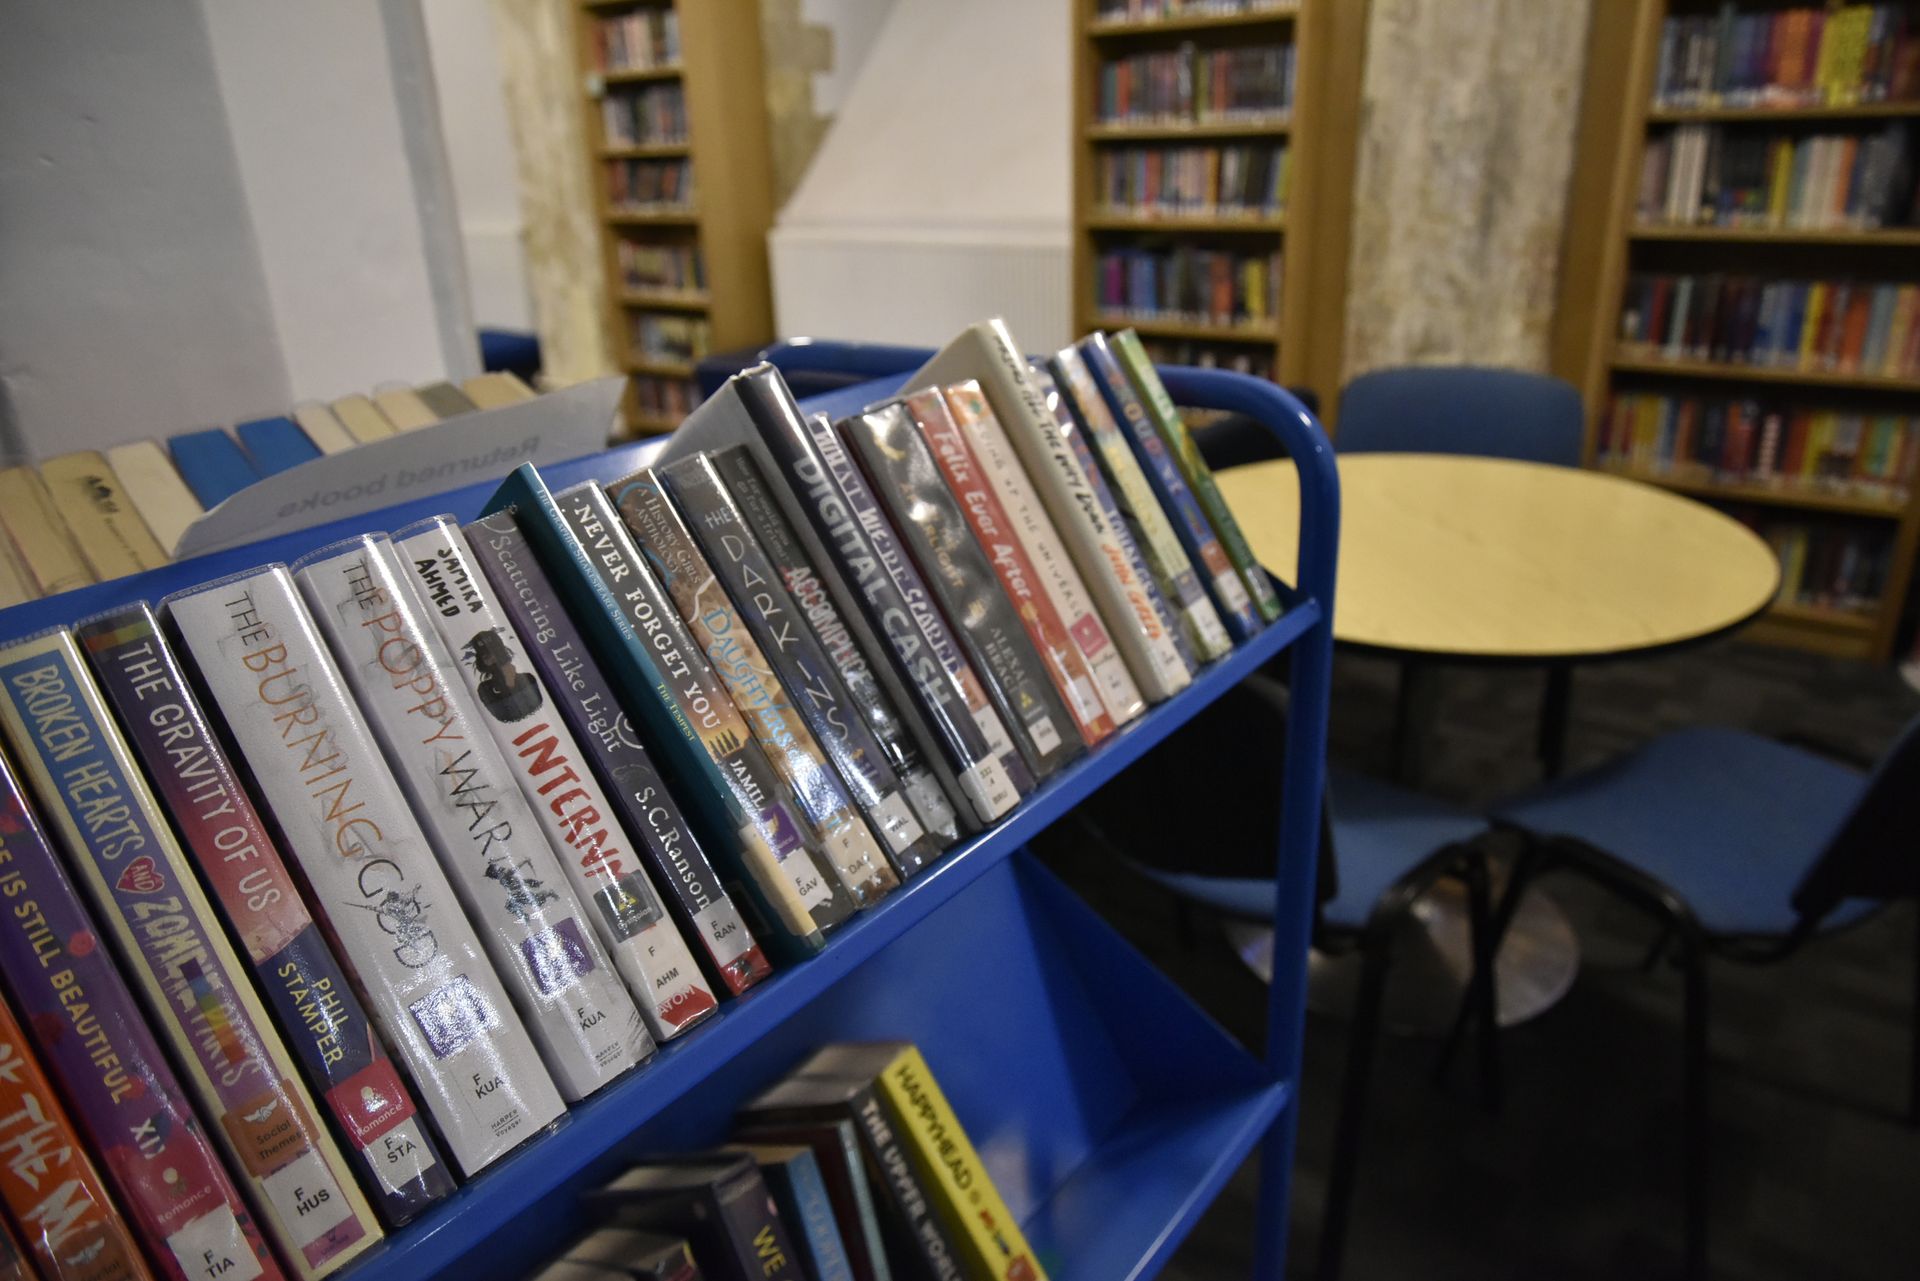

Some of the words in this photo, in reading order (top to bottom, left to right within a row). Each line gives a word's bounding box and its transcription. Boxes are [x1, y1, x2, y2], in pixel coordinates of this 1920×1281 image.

[814, 431, 865, 499] WHAT
[933, 432, 969, 483] Felix
[965, 490, 998, 537] Ever
[992, 543, 1031, 598] After
[1018, 505, 1036, 534] THE
[343, 558, 384, 610] THE
[415, 558, 461, 618] AHMED
[437, 546, 484, 614] SAMIRA
[793, 457, 888, 604] DIGITAL
[882, 607, 951, 709] CASH
[224, 590, 270, 647] THE
[489, 535, 557, 645] Scattering
[552, 642, 587, 692] Like
[582, 692, 621, 752] Light
[574, 504, 630, 583] NEVER
[625, 587, 691, 679] FORGET
[684, 681, 721, 729] YOU
[610, 609, 633, 641] SERIES
[787, 566, 874, 692] ACCOMPLICE
[362, 611, 464, 745] POPPY
[703, 607, 794, 748] DAUGHTERS
[656, 682, 671, 702] THE
[668, 700, 695, 742] TEMPEST
[12, 663, 95, 763] BROKEN
[64, 760, 146, 861] HEARTS
[131, 864, 155, 891] AND
[118, 642, 172, 701] THE
[149, 703, 236, 820] GRAVITY
[214, 825, 260, 862] OF
[238, 867, 281, 912] US
[242, 643, 383, 858] BURNING
[440, 749, 512, 856] WAR
[730, 758, 766, 812] JAMIL
[798, 878, 819, 897] GAV
[713, 921, 737, 942] RAN
[0, 870, 28, 898] IS
[14, 900, 61, 969] STILL
[50, 968, 132, 1105] BEAUTIFUL
[311, 977, 349, 1033] PHIL
[656, 967, 680, 990] AHM
[278, 962, 344, 1067] STAMPER
[579, 1010, 606, 1032] KUA
[475, 1076, 504, 1100] KUA
[0, 1091, 73, 1192] THE
[256, 1119, 291, 1145] Social
[355, 1103, 405, 1138] Romance
[490, 1108, 518, 1130] HARPER
[894, 1063, 974, 1191] HAPPYHEAD
[387, 1141, 417, 1163] STA
[861, 1097, 893, 1149] THE
[883, 1146, 926, 1221] UPPER
[157, 1185, 212, 1224] Romance
[296, 1189, 330, 1216] HUS
[205, 1257, 235, 1279] TIA
[753, 1224, 787, 1278] WE
